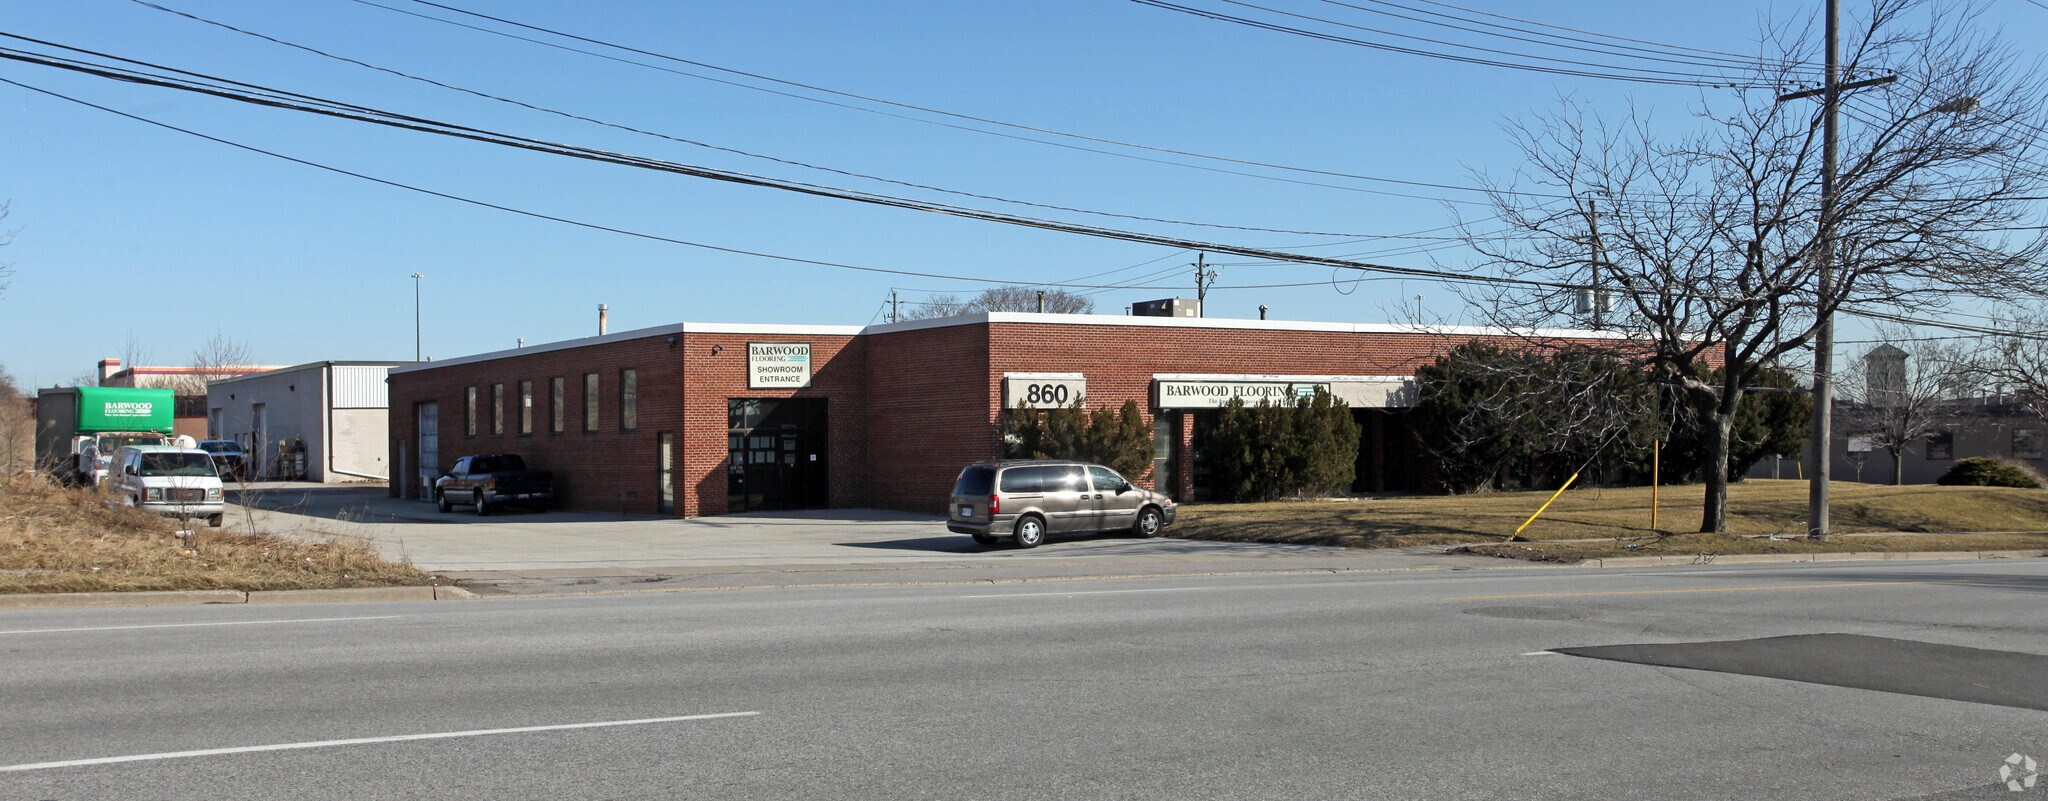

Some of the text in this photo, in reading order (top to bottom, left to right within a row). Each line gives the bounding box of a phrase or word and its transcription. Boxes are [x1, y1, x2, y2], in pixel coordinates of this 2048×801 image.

[751, 346, 808, 355] BARWOOD
[1027, 383, 1068, 404] 860
[1166, 384, 1290, 398] BARWOOD FLOORIN
